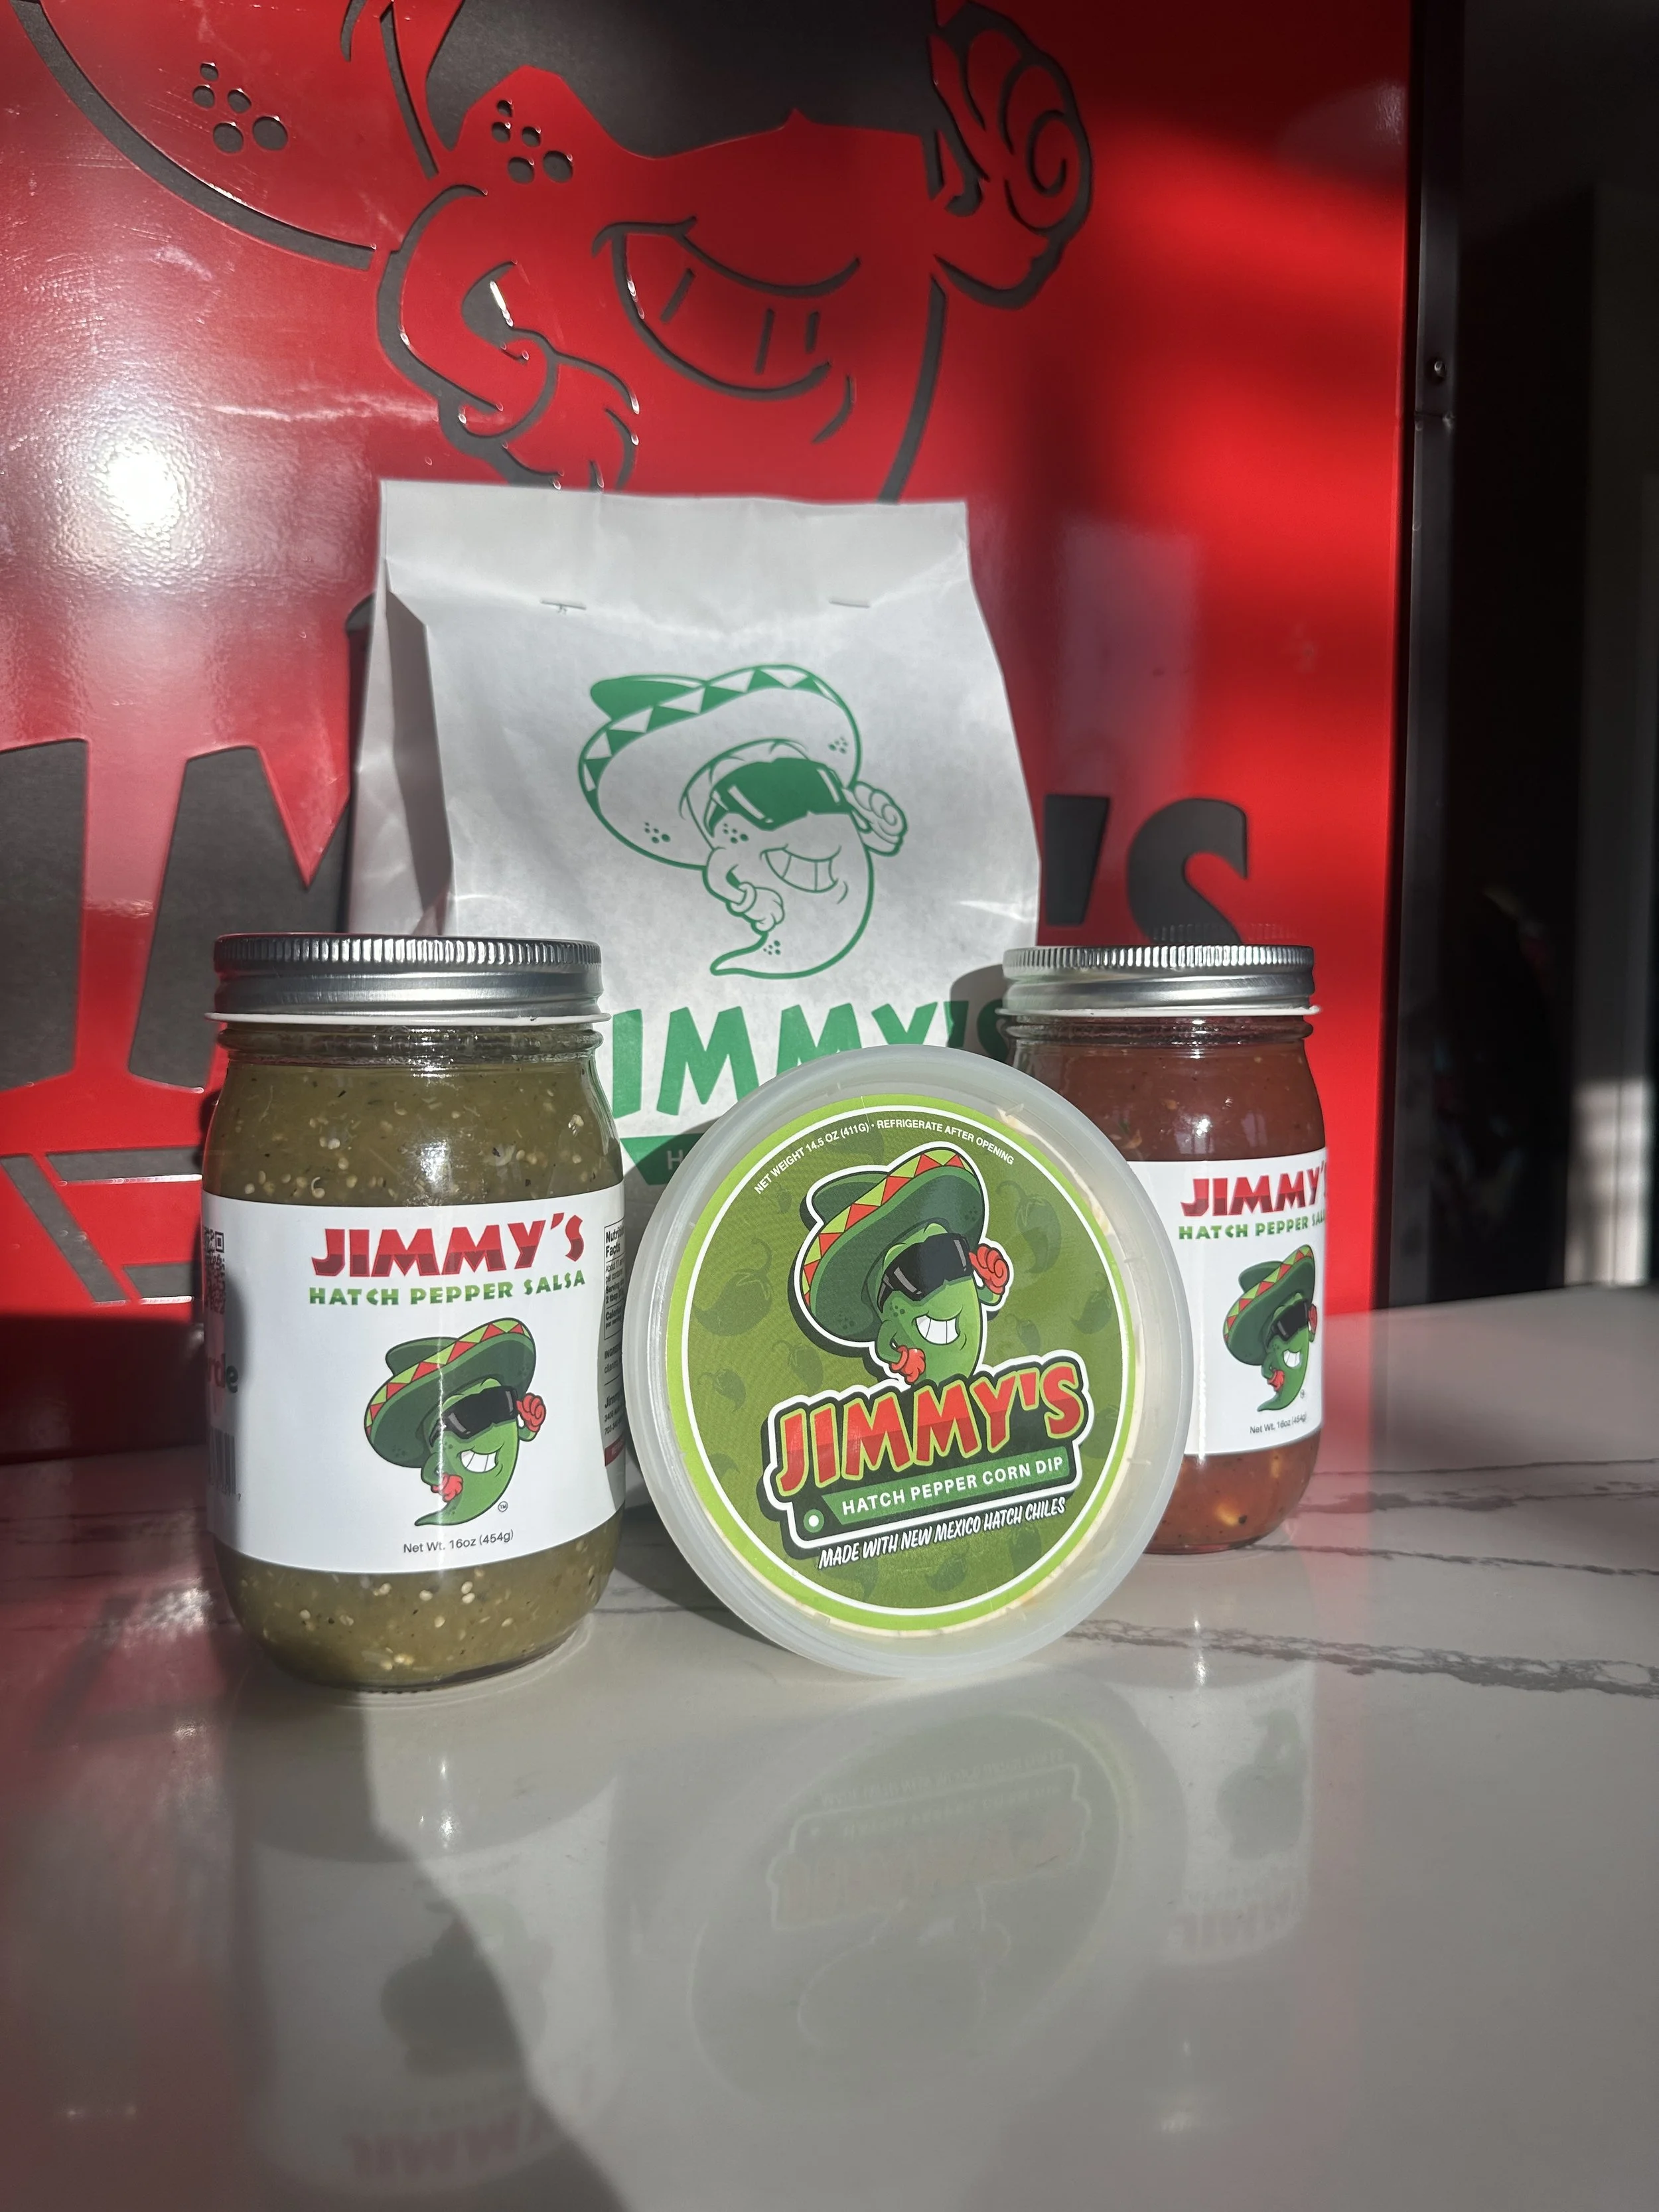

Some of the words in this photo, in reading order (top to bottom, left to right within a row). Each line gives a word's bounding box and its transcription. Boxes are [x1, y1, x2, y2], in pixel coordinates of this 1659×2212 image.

[754, 1173, 772, 1195] NET
[770, 1147, 805, 1177] WEIGHT
[806, 1138, 824, 1153] 14.5
[825, 1132, 840, 1143] OZ
[840, 1122, 870, 1139] (411G)
[877, 1119, 942, 1132] REFRIGERATE
[944, 1126, 974, 1142] AFTER
[976, 1137, 1015, 1165] OPENING
[312, 1213, 585, 1278] JIMMY'S
[1179, 1224, 1248, 1240] HATCH
[1255, 1215, 1308, 1236] PEPPER
[309, 1287, 399, 1305] HATCH
[411, 1281, 513, 1305] PEPPER
[524, 1270, 585, 1295] SALSA
[776, 1361, 1084, 1496] JIMMY'S
[1250, 1426, 1262, 1434] Net
[1264, 1423, 1275, 1432] Wt.
[1277, 1420, 1291, 1429] 16oz
[842, 1489, 905, 1515] HATCH
[910, 1475, 977, 1501] PEPPER
[982, 1463, 1031, 1485] CORN
[1035, 1456, 1063, 1474] DIP
[403, 1543, 423, 1553] Net
[427, 1541, 446, 1552] Wt.
[449, 1538, 476, 1550] 16oz
[479, 1529, 514, 1546] (454g)
[818, 1542, 859, 1570] MADE
[863, 1533, 899, 1558] WITH
[901, 1526, 933, 1550] NEW
[934, 1516, 981, 1543] MEXICO
[983, 1505, 1022, 1531] HATCH
[1025, 1496, 1066, 1521] CHILES
